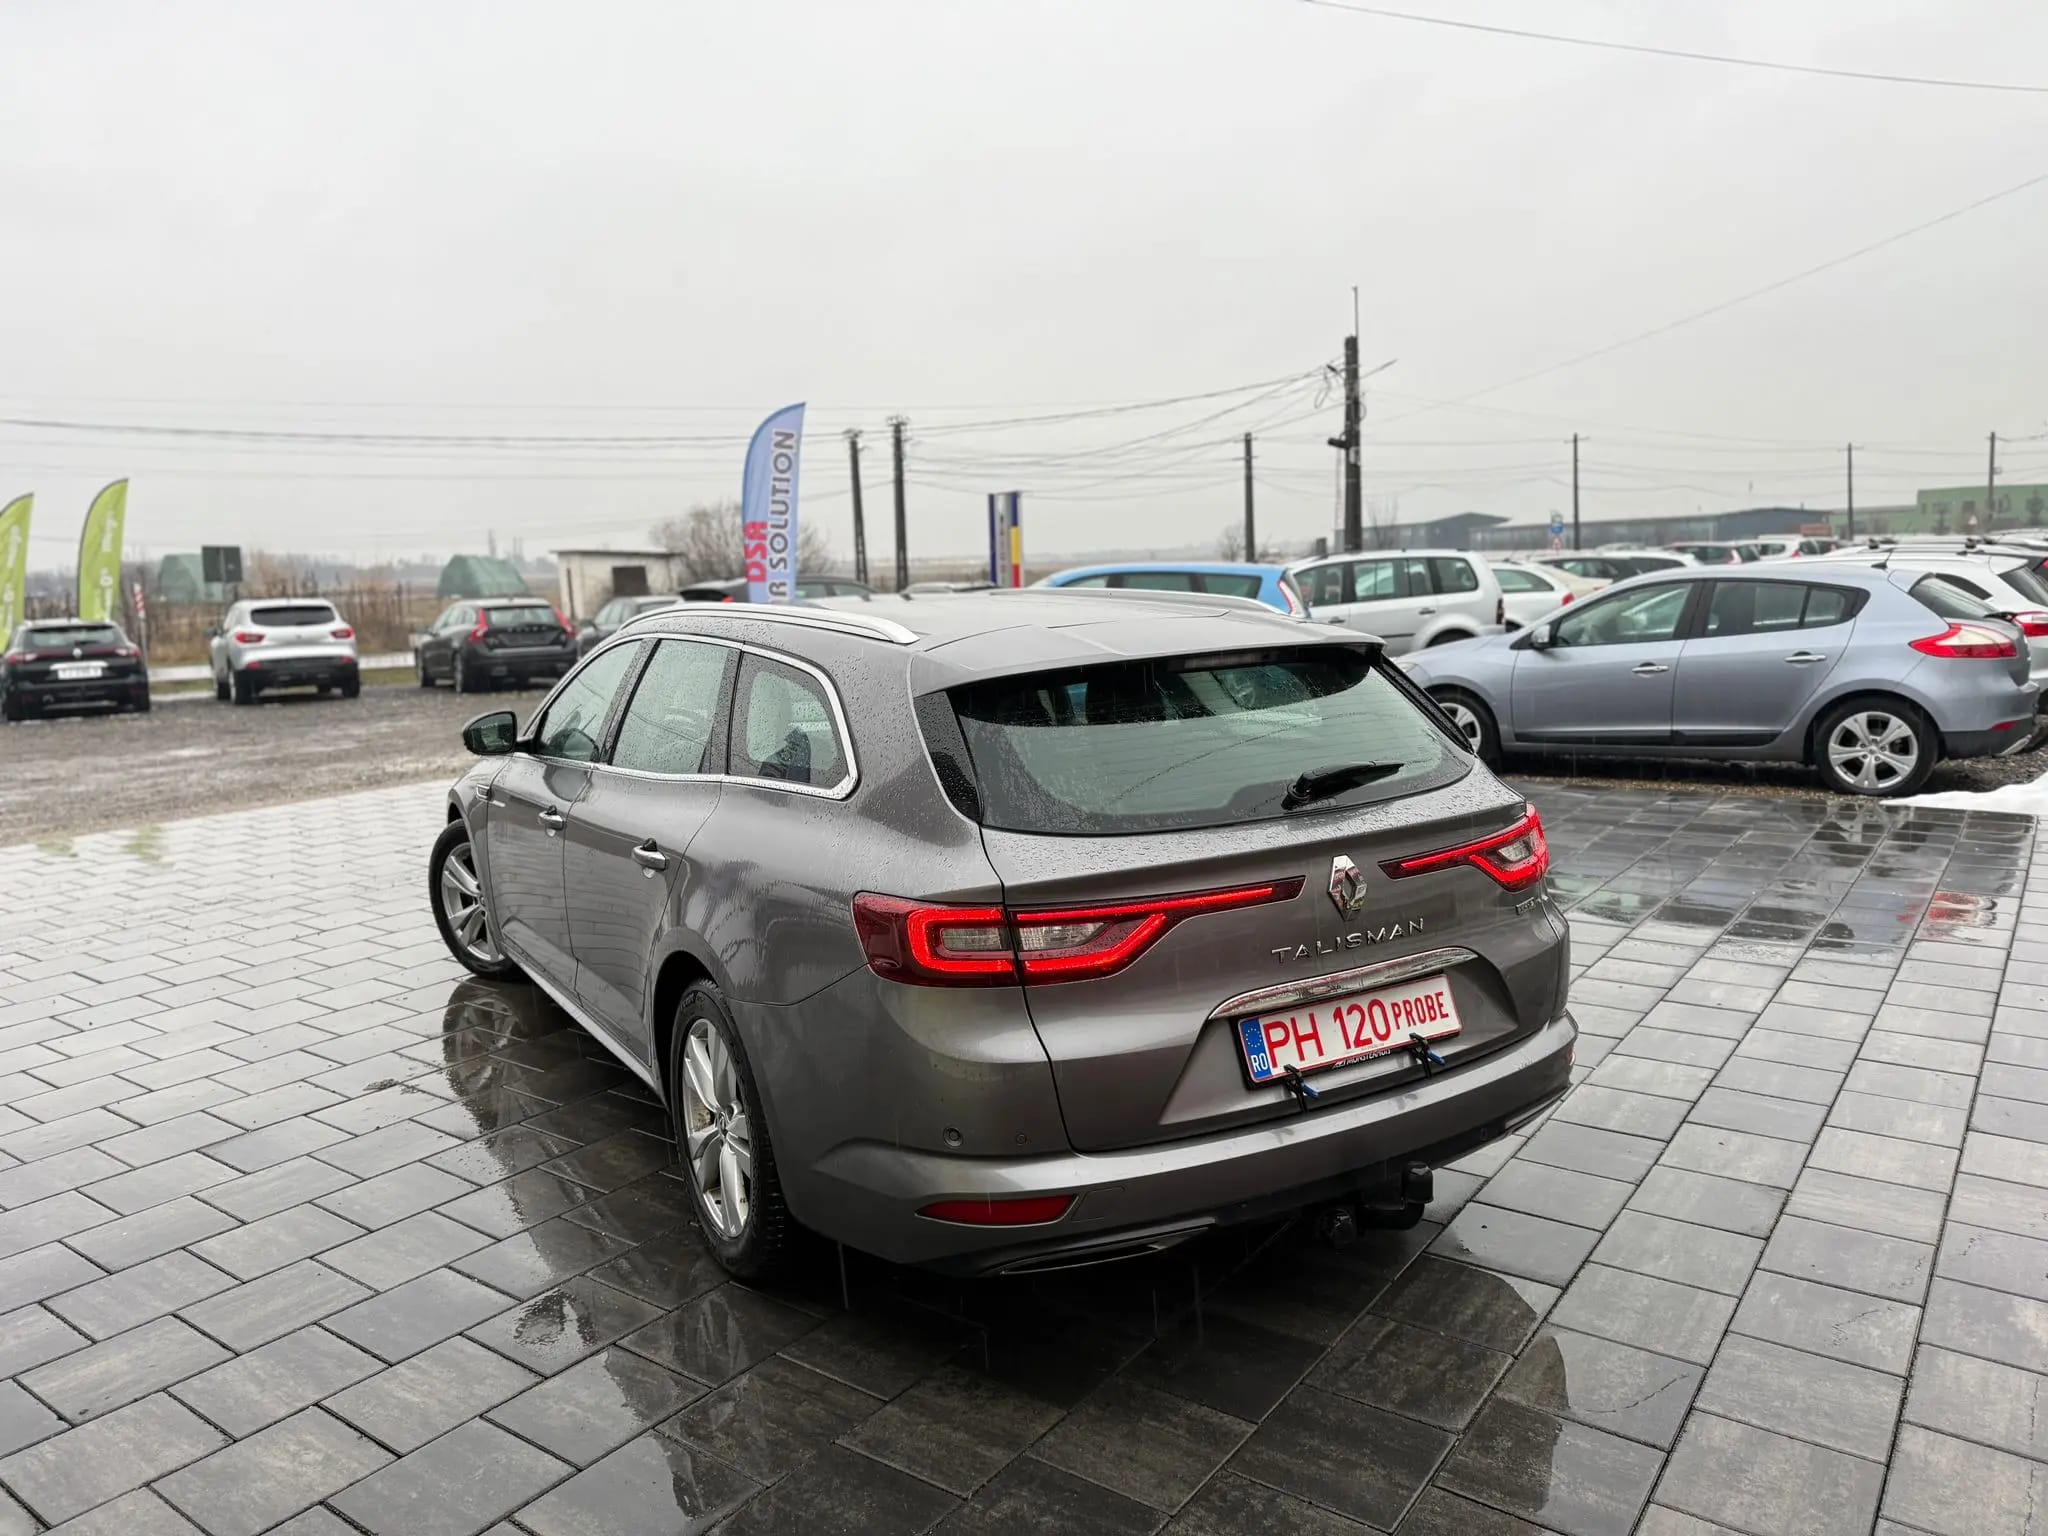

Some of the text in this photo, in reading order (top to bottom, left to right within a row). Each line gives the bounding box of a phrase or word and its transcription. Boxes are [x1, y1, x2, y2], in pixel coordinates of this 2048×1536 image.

[769, 431, 795, 570] SOLUTION
[743, 521, 768, 583] DSA
[1271, 918, 1424, 963] TALISMAN
[1263, 1012, 1325, 1069] PH
[1333, 998, 1392, 1049] 120
[1392, 991, 1449, 1031] PROBE
[1250, 1052, 1269, 1074] RO
